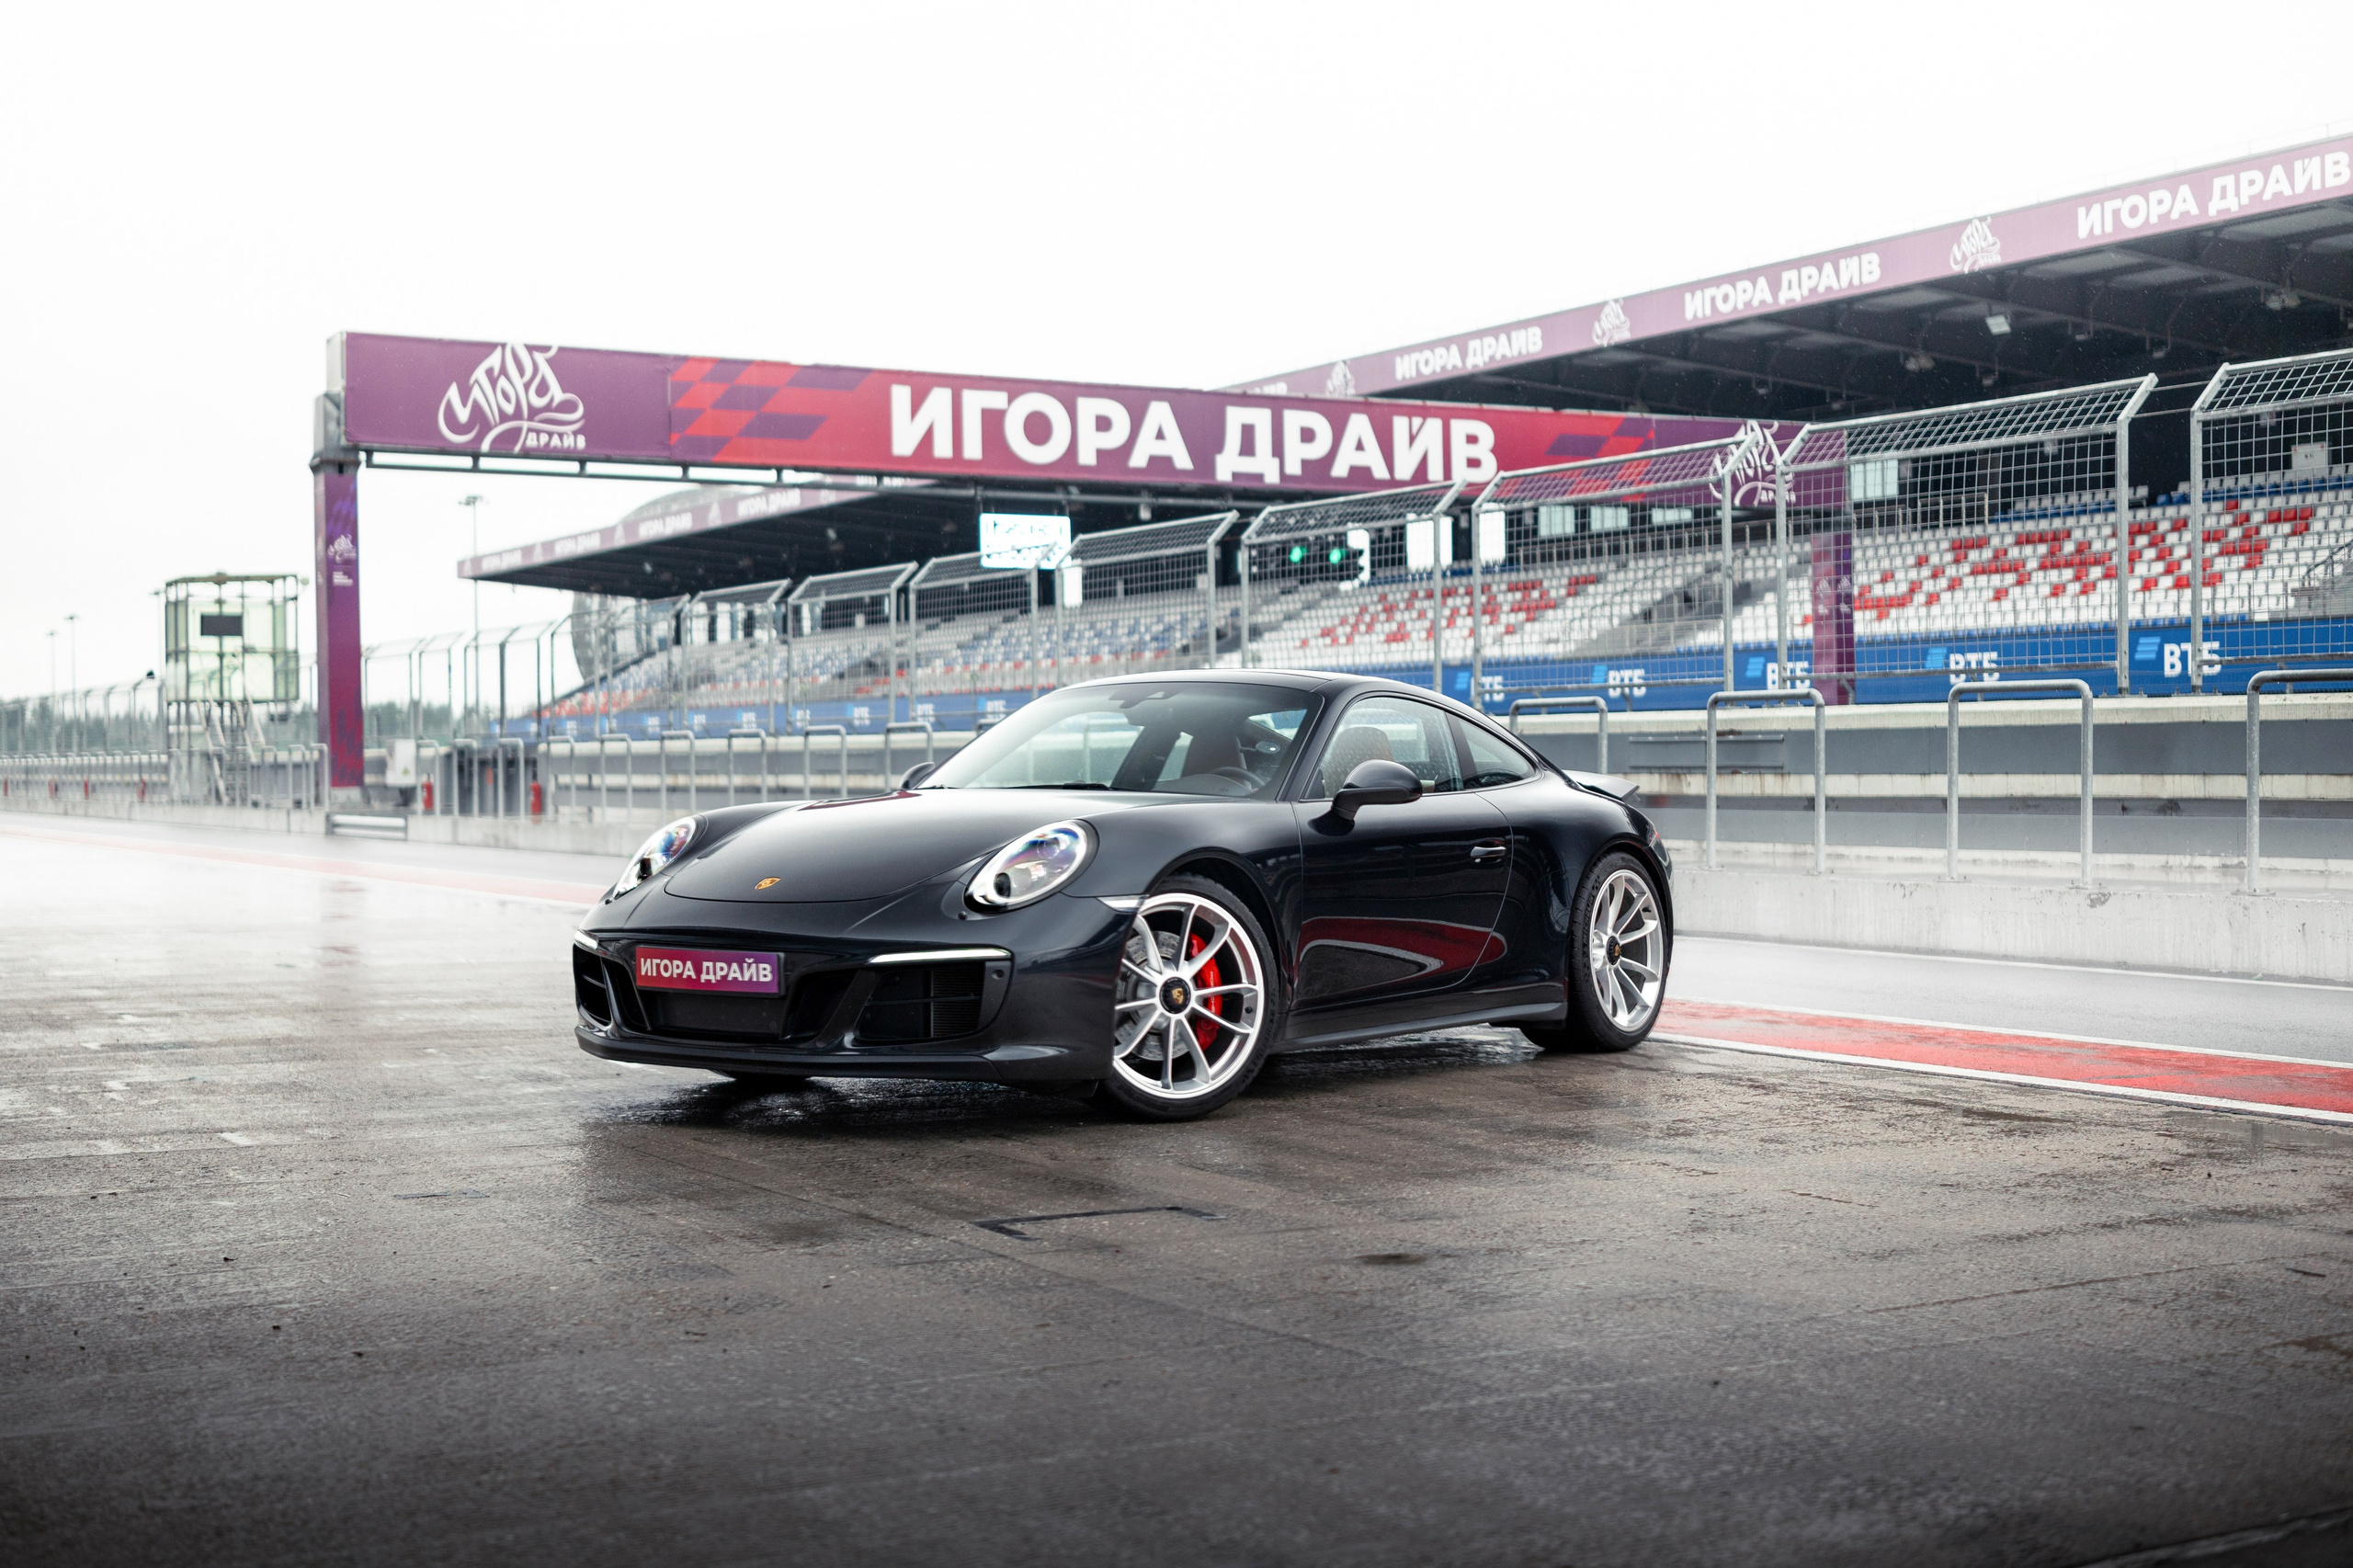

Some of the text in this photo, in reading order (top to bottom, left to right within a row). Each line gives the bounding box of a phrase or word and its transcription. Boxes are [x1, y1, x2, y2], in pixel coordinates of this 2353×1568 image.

[2077, 151, 2351, 240] ИГОРА ДРАЙВ
[1684, 252, 1881, 321] ИГОРА ДРАЙВ
[1394, 344, 1463, 381] ИГОРА
[1465, 326, 1543, 369] ДРАЙВ
[526, 430, 586, 450] ДРАЙВ
[890, 384, 1497, 484] ИГОРА ДРАЙВ
[1608, 668, 1647, 699] ВТБ
[1949, 652, 1999, 686] ВТБ
[641, 958, 773, 983] ИГОРА ДРАЙВ
